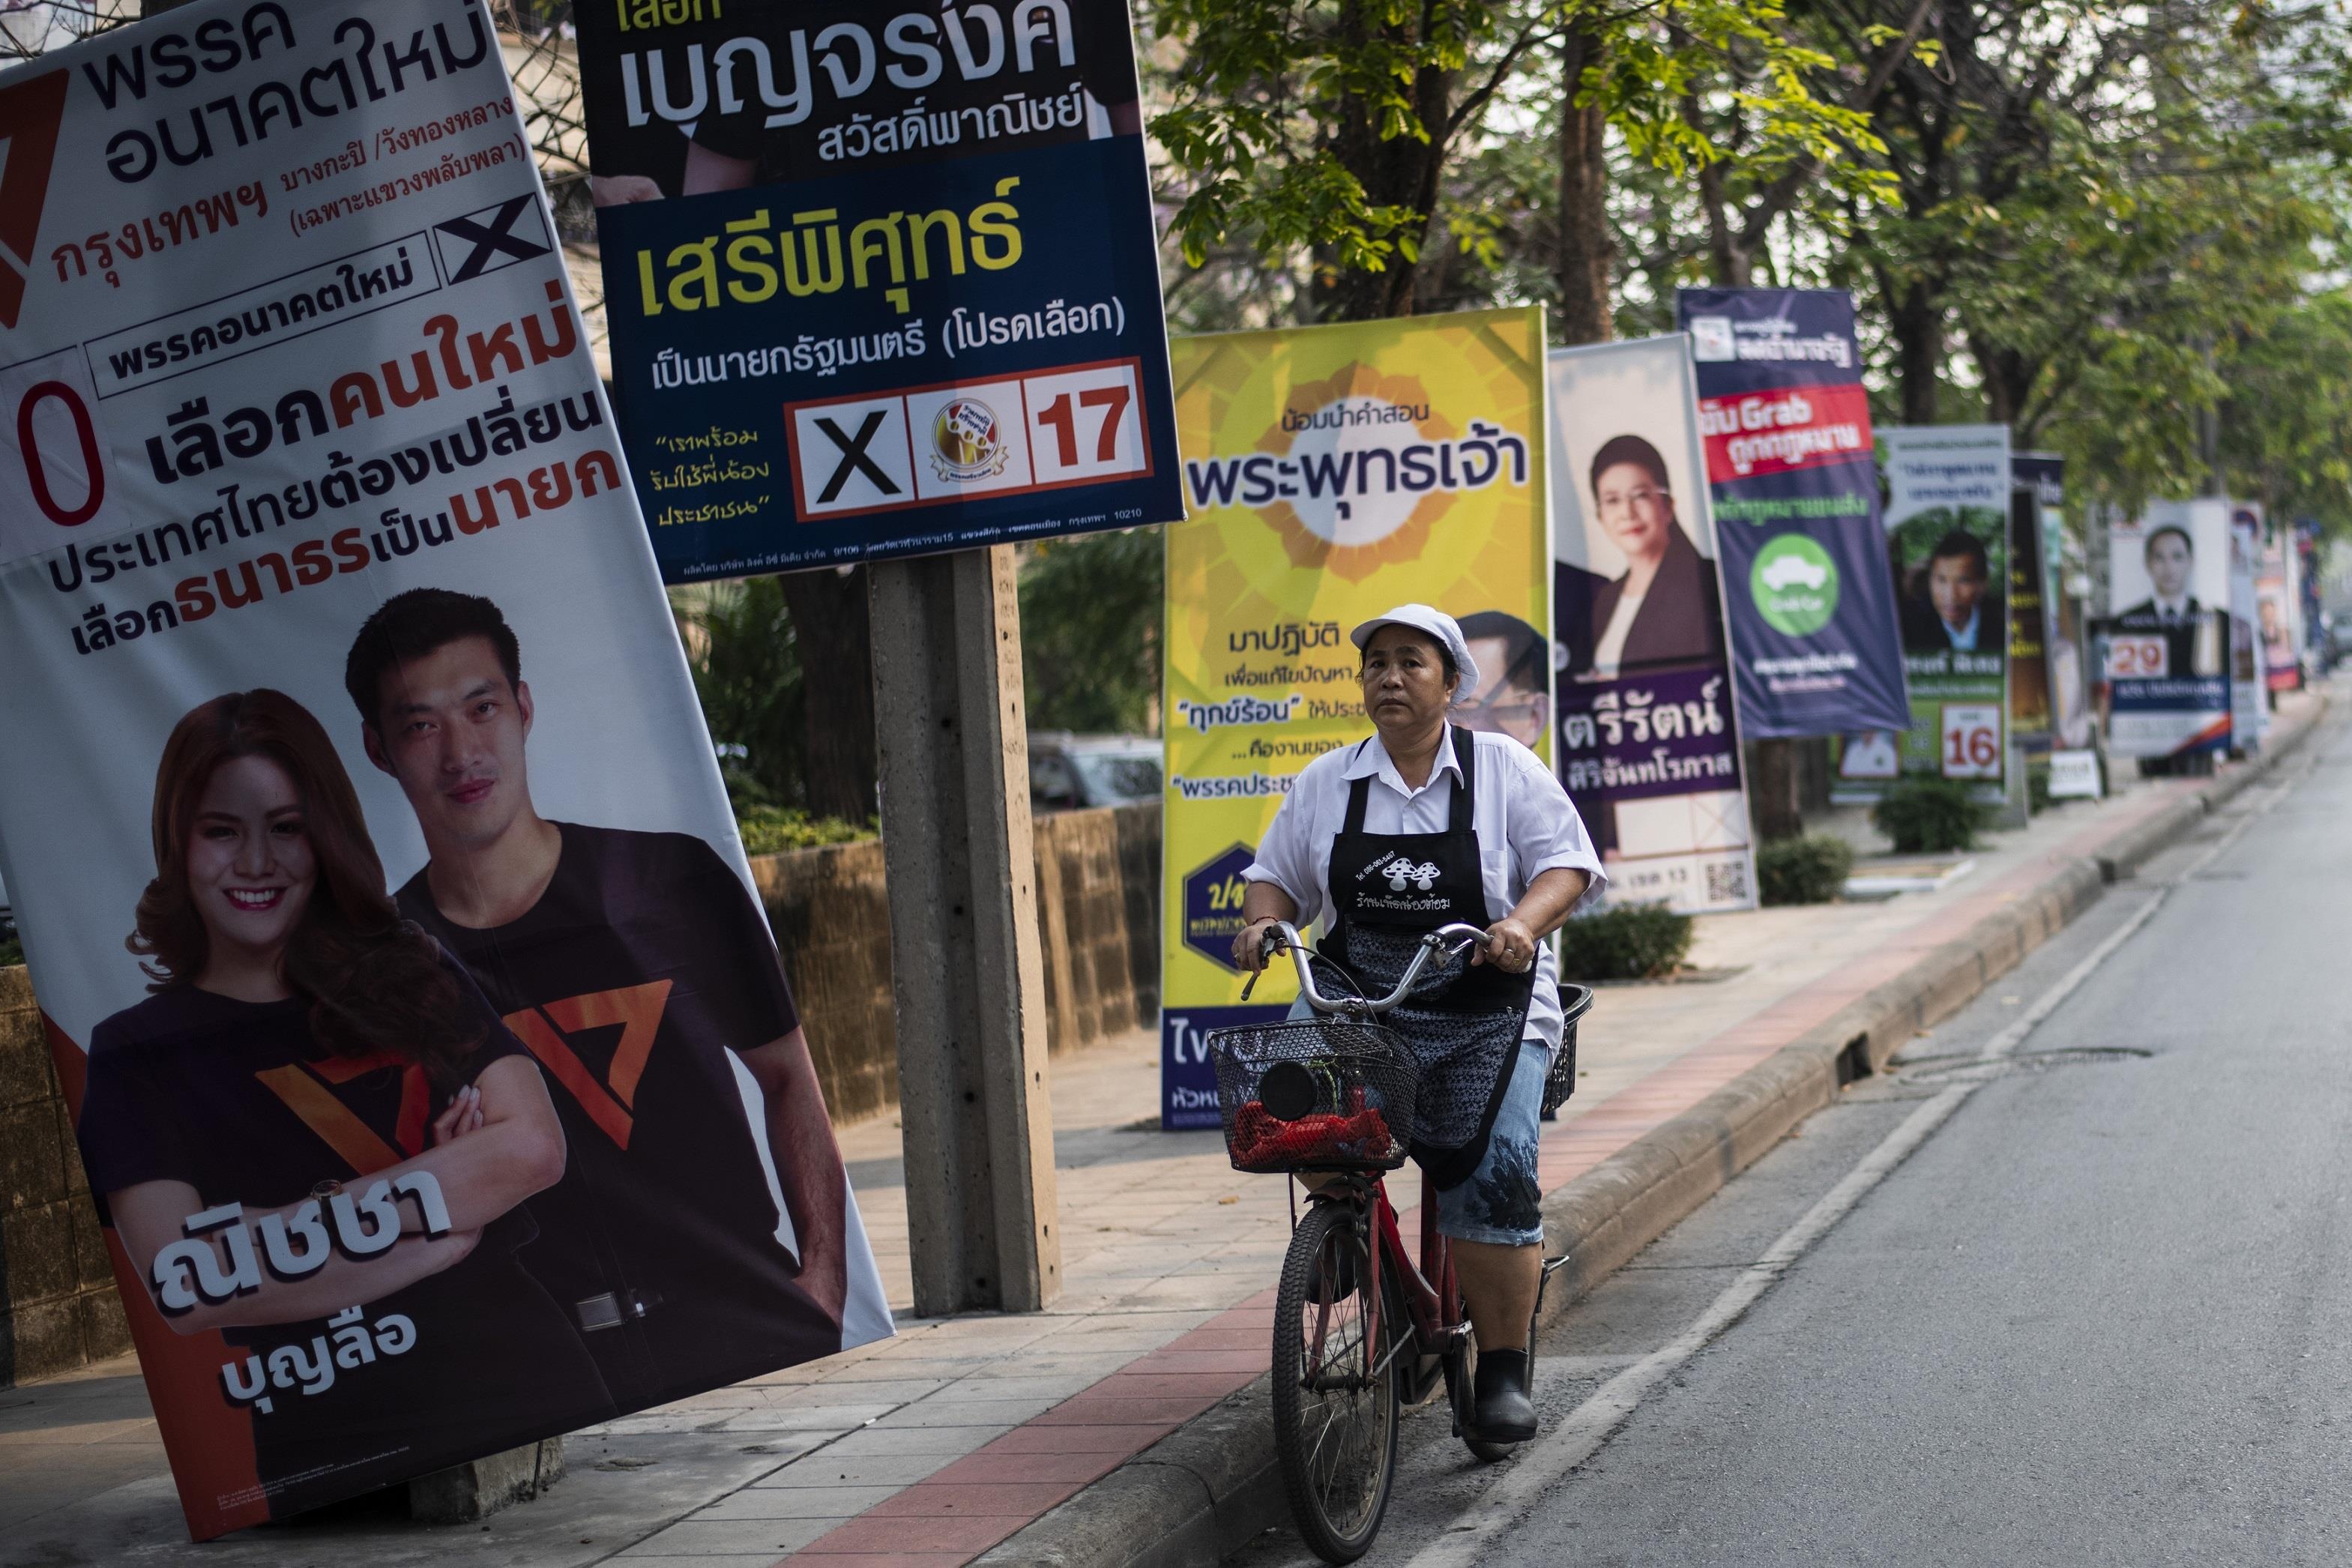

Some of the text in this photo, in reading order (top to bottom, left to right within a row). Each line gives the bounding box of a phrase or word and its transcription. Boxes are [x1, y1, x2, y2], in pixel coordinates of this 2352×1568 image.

[82, 1, 296, 111] พรรค
[106, 0, 488, 184] อนาคตใหม่
[621, 0, 1076, 128] เบญจรงค
[818, 81, 1085, 161] สวัสดิ์พาณิชย์
[51, 178, 269, 289] กรุงเทพฯ
[290, 133, 526, 238] (เฉพาะแขวงพลับพลา)
[637, 176, 1024, 316] เสรีพิศุทธ์
[109, 247, 414, 380] พรรคอนาคตใหม่
[651, 297, 1126, 390] เป็นนายกรัฐมนตรี (โปรดเลือก)
[145, 280, 578, 485] เลือกคนใหม่
[1037, 385, 1131, 468] 17
[1282, 402, 1429, 433] น้อมนำคำสอน
[1740, 392, 1813, 432] Grab
[48, 384, 603, 593] ประเทศไทยต้องเปลี่ยน
[650, 453, 770, 491] รับใช้พี่น้อง
[1069, 513, 1107, 526] กรุงเทพฯ
[1114, 508, 1142, 520] 10210
[1186, 421, 1525, 521] พระพุทธเจ้า
[71, 449, 622, 655] เลือกธนาธรเป็นนายก
[1225, 663, 1354, 687] เพื่อแก้ไขปัญหา
[1229, 621, 1340, 657] มาปฏิบัติ
[2114, 642, 2162, 672] 29
[1564, 675, 1723, 750] ตรีรัตน์
[1947, 727, 1996, 768] 16
[153, 1170, 452, 1309] ณิชชา
[221, 1304, 417, 1415] บุญลือ
